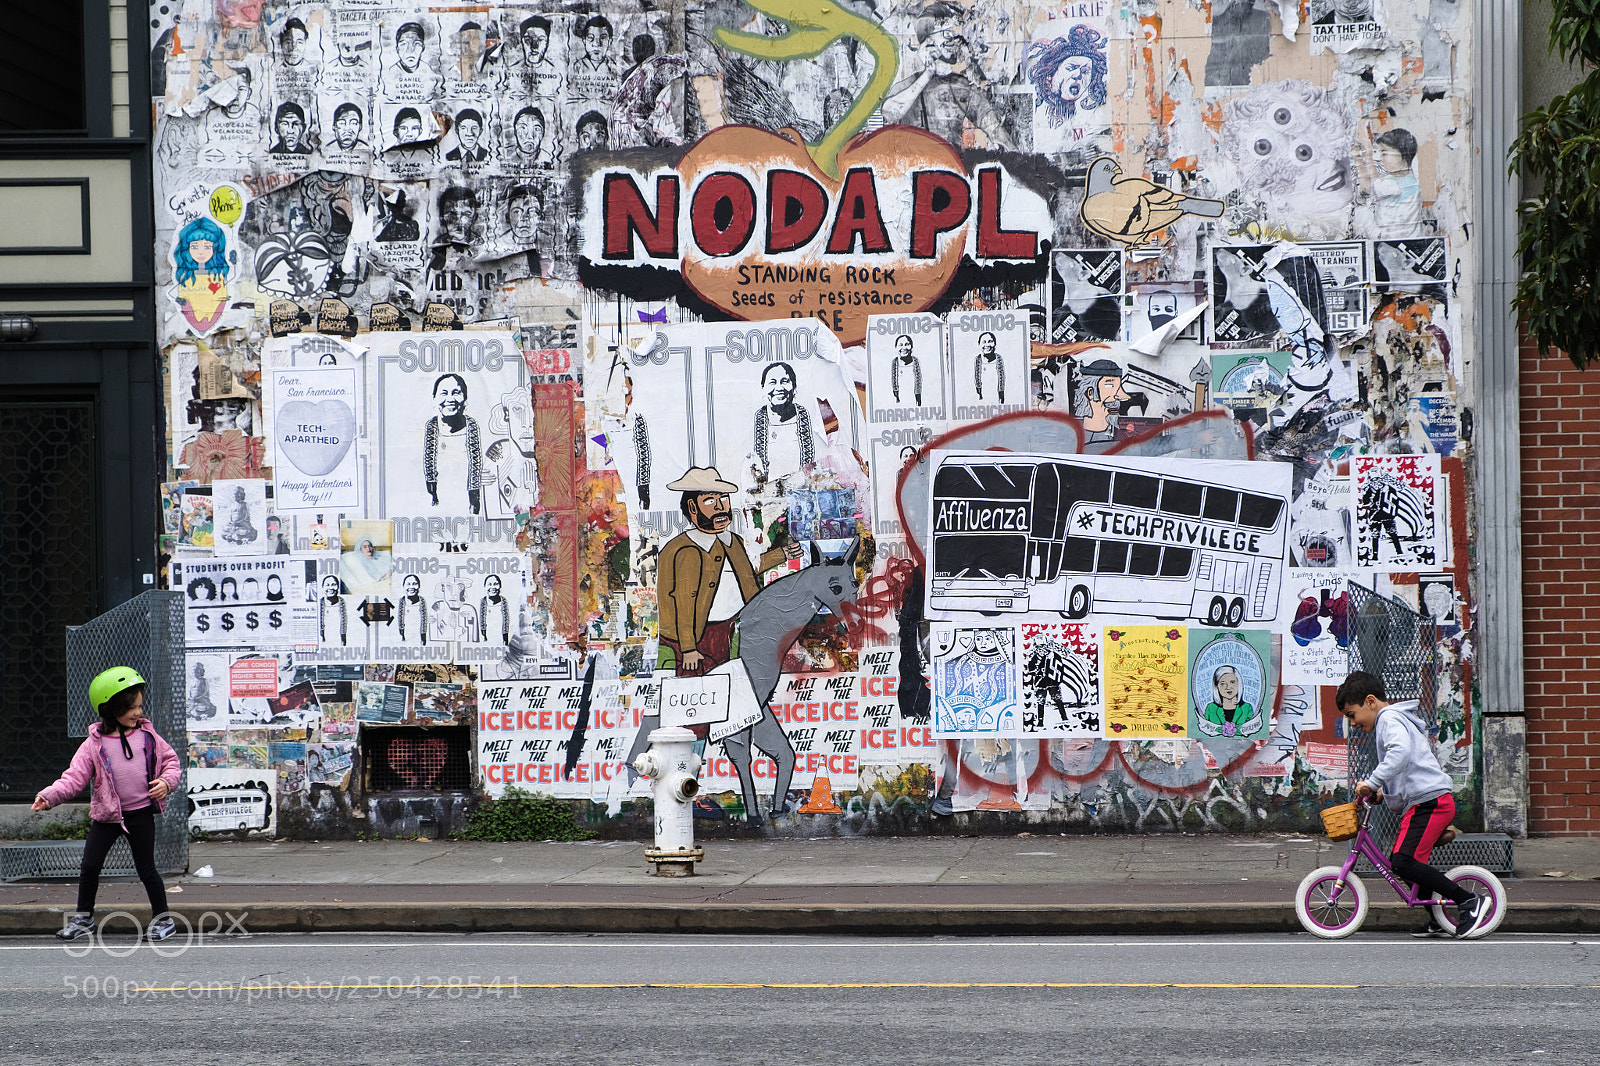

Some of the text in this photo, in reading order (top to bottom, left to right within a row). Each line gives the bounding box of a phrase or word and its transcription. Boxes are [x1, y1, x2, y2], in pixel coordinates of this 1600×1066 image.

[1314, 23, 1381, 36] TAX THE RICH
[1313, 35, 1336, 43] DON'T
[187, 183, 211, 206] with
[1322, 256, 1359, 265] TRANSIT
[737, 264, 897, 287] STANDING ROCK
[789, 289, 806, 306] of
[819, 289, 914, 307] resistance
[877, 317, 932, 337] SOMOS
[960, 313, 1017, 333] SOMOS
[725, 327, 826, 363] SOMO
[397, 338, 505, 373] SOMOS
[286, 387, 305, 398] San
[545, 399, 570, 408] STAND
[874, 406, 943, 424] MARICHUY
[297, 424, 327, 433] TECH-
[284, 435, 341, 446] APARTHEID
[281, 479, 309, 494] Happy
[302, 491, 333, 507] Day!!!
[935, 499, 1029, 532] Affluenza
[1076, 508, 1261, 554] #TECHPRIVILEGE
[186, 560, 286, 575] STUDENTS OVER PROFIT
[466, 556, 520, 575] SOMOS
[1312, 577, 1343, 589] Lungs
[196, 612, 210, 634] $
[221, 611, 235, 633] $
[246, 611, 259, 632] $
[269, 608, 283, 630] $
[381, 646, 447, 661] MARICHUY
[463, 646, 511, 661] MARIC
[863, 651, 895, 666] MELT
[872, 663, 891, 675] THE
[786, 677, 818, 692] MELT
[824, 676, 857, 690] MELT
[860, 676, 898, 697] ICE
[482, 686, 514, 701] MELT
[519, 686, 552, 699] MELT
[557, 686, 582, 700] MEL
[596, 686, 619, 700] MEL
[669, 691, 717, 708] GUCCI
[795, 690, 815, 702] THE
[833, 688, 852, 700] THE
[490, 699, 510, 710] THE
[528, 697, 548, 709] THE
[743, 712, 762, 726] KORS
[784, 703, 820, 723] ICE
[822, 701, 859, 722] ICE
[863, 704, 895, 719] MELT
[480, 711, 515, 731] ICE
[517, 709, 552, 730] ICE
[555, 710, 592, 731] IC
[872, 716, 891, 728] THE
[787, 728, 818, 742] MELT
[824, 729, 856, 744] MELT
[860, 729, 897, 750] ICE
[900, 727, 937, 747] ICE
[483, 739, 514, 753] MELT
[520, 739, 552, 752] MELT
[795, 740, 815, 752] THE
[832, 741, 852, 754] THE
[491, 752, 511, 763] THE
[529, 751, 548, 763] THE
[793, 753, 820, 774] CE
[517, 762, 552, 784] ICE
[750, 758, 778, 779] CE
